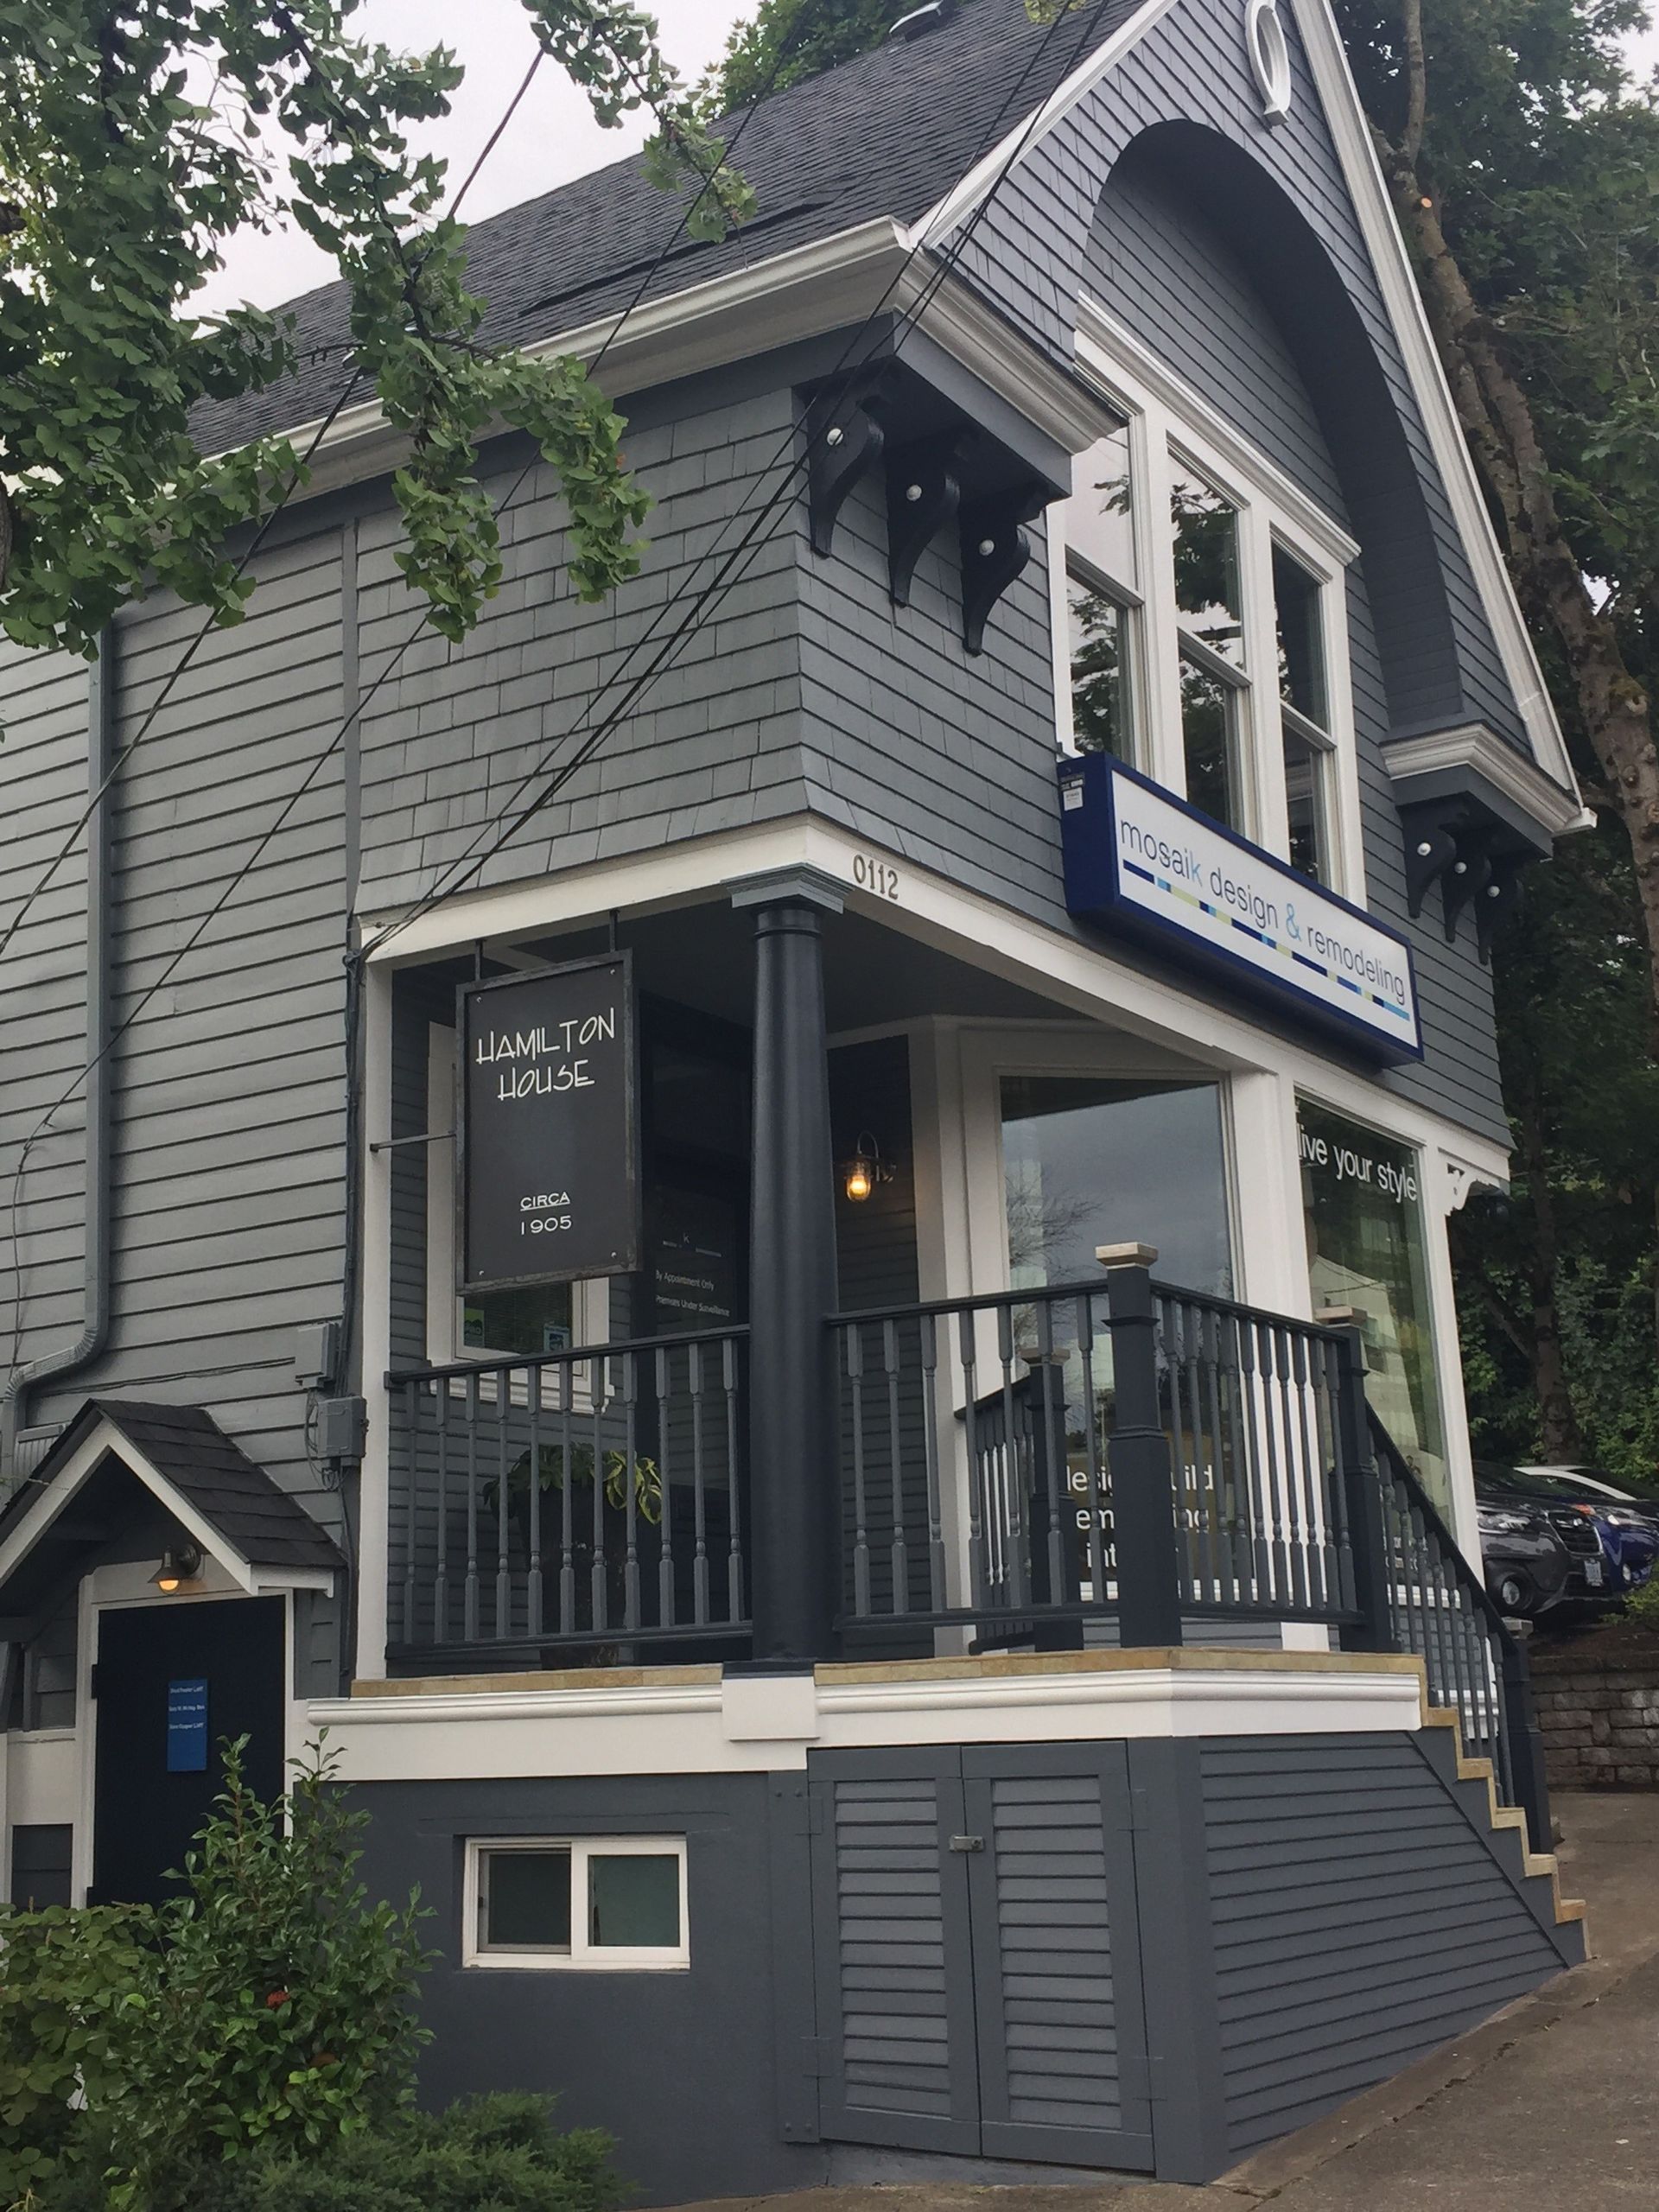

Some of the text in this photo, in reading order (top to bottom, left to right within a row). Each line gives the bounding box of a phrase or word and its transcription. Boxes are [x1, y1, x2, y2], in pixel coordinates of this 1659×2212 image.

[853, 855, 899, 900] 0112
[1121, 820, 1405, 1006] mosaik design & remodeling
[476, 1007, 614, 1065] HAMILTON
[498, 1059, 595, 1101] HOUSE
[1297, 1123, 1418, 1204] live your style
[520, 1192, 570, 1211] CIRCA
[521, 1215, 572, 1236] 1905
